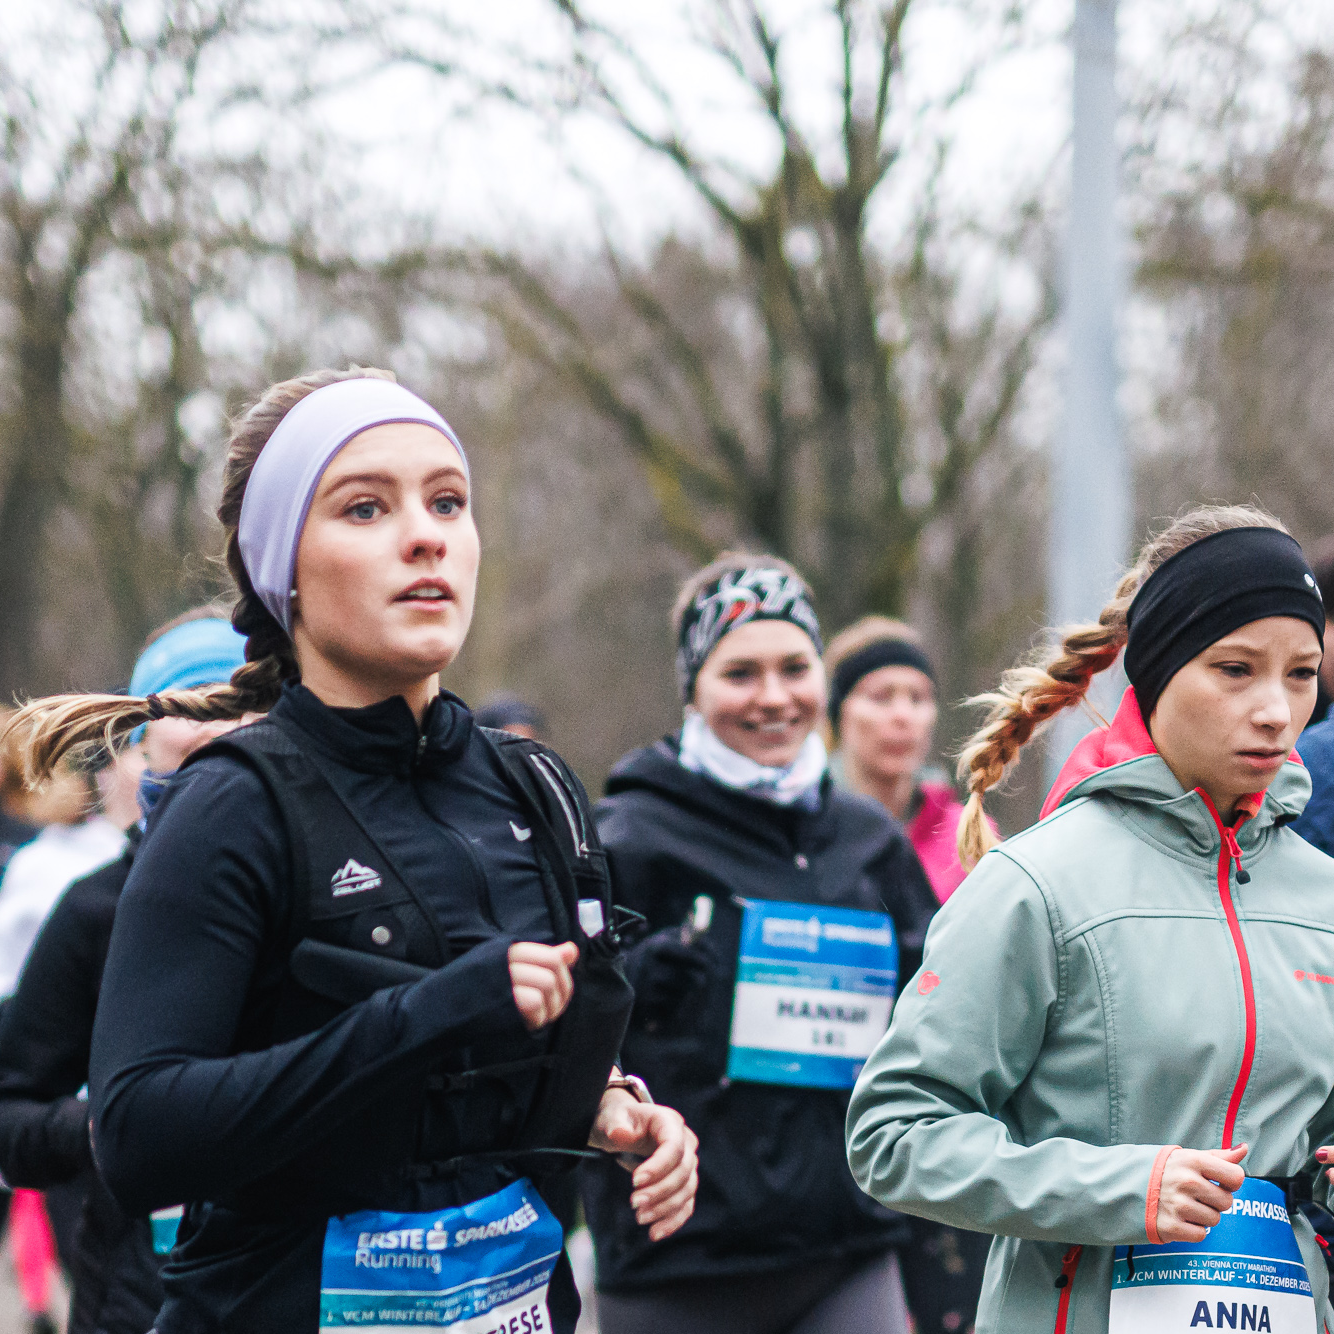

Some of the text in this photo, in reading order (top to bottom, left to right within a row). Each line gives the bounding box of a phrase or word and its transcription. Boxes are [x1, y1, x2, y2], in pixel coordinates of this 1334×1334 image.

[357, 1228, 425, 1250] ERSTE
[355, 1250, 442, 1274] Running
[1188, 1260, 1277, 1274] 43. VIENNA CITY MARATHON
[1116, 1275, 1125, 1284] 1.
[1158, 1269, 1235, 1282] WINTERLAUF
[1246, 1273, 1258, 1285] 14.
[1260, 1274, 1298, 1290] DEZEMBER
[343, 1310, 375, 1322] VCM
[1190, 1301, 1272, 1333] ANNA
